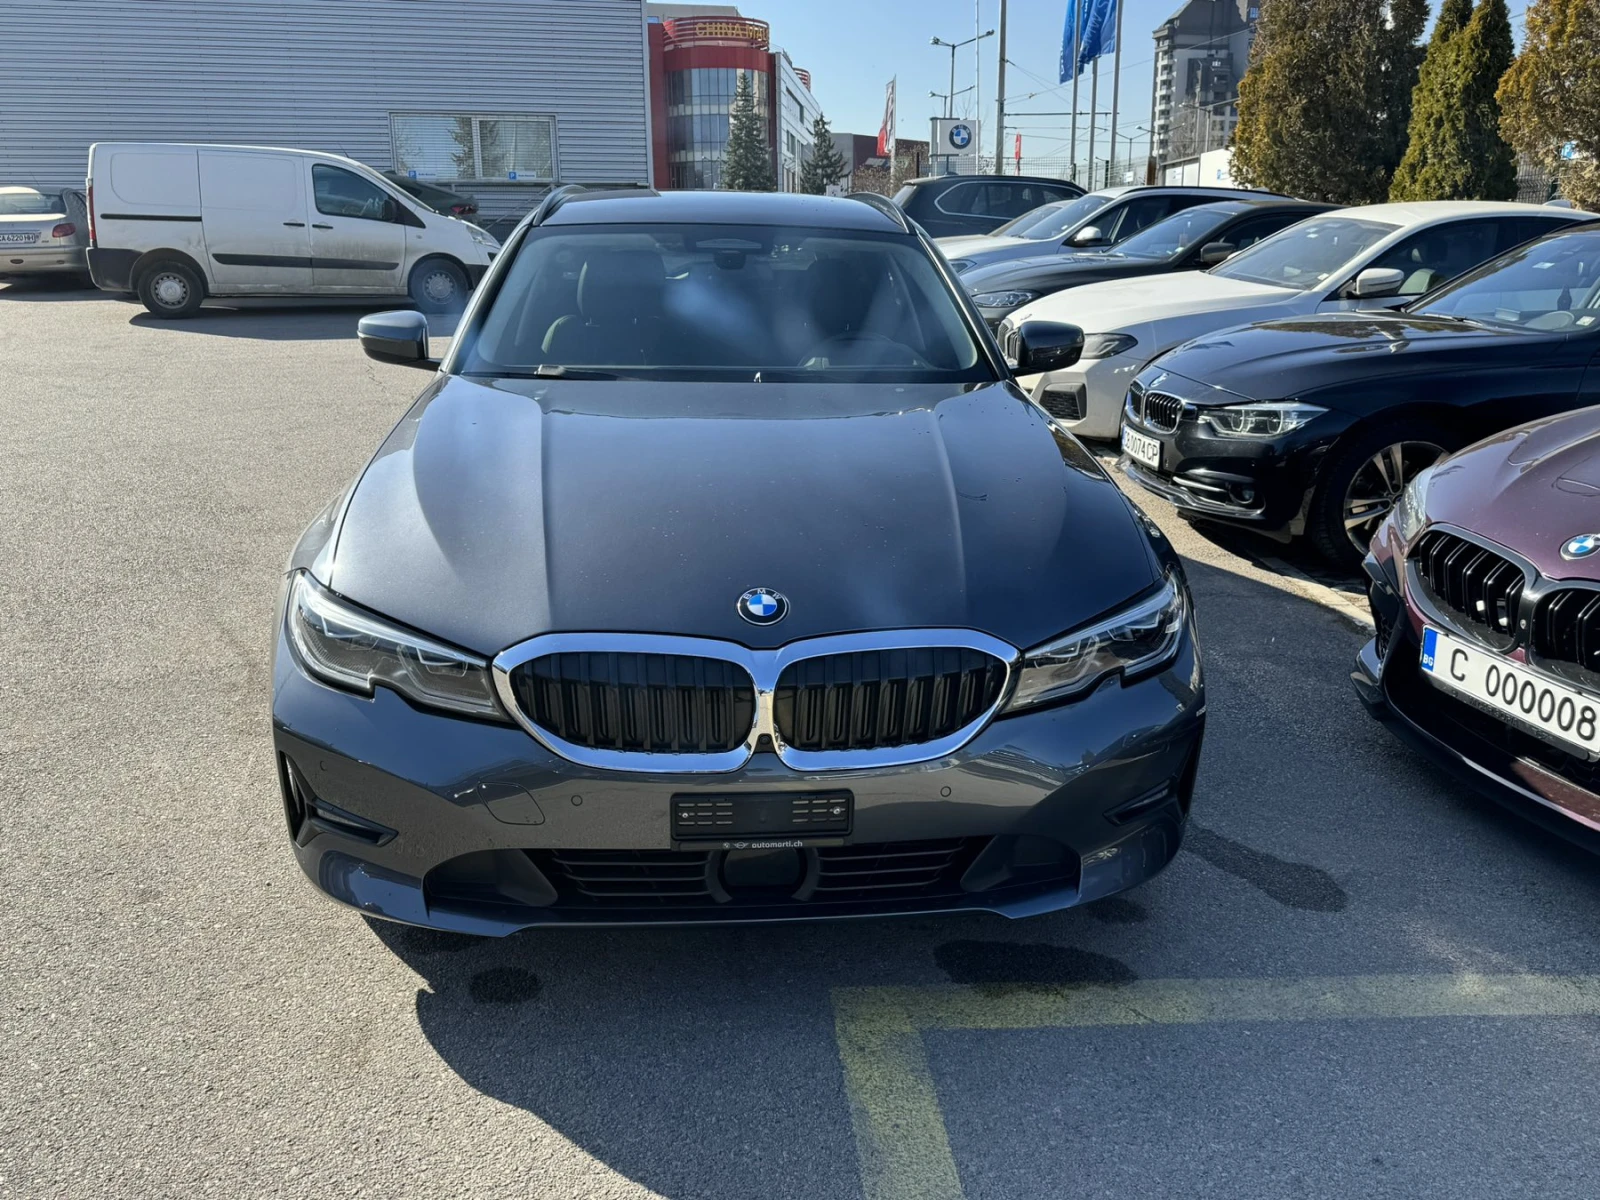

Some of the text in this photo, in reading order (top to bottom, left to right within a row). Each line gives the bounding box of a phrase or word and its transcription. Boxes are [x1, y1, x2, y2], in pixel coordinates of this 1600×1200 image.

[696, 22, 743, 38] CHINA
[1423, 655, 1434, 667] BG
[1485, 664, 1596, 741] 000008
[751, 840, 803, 849] automarti.ch
